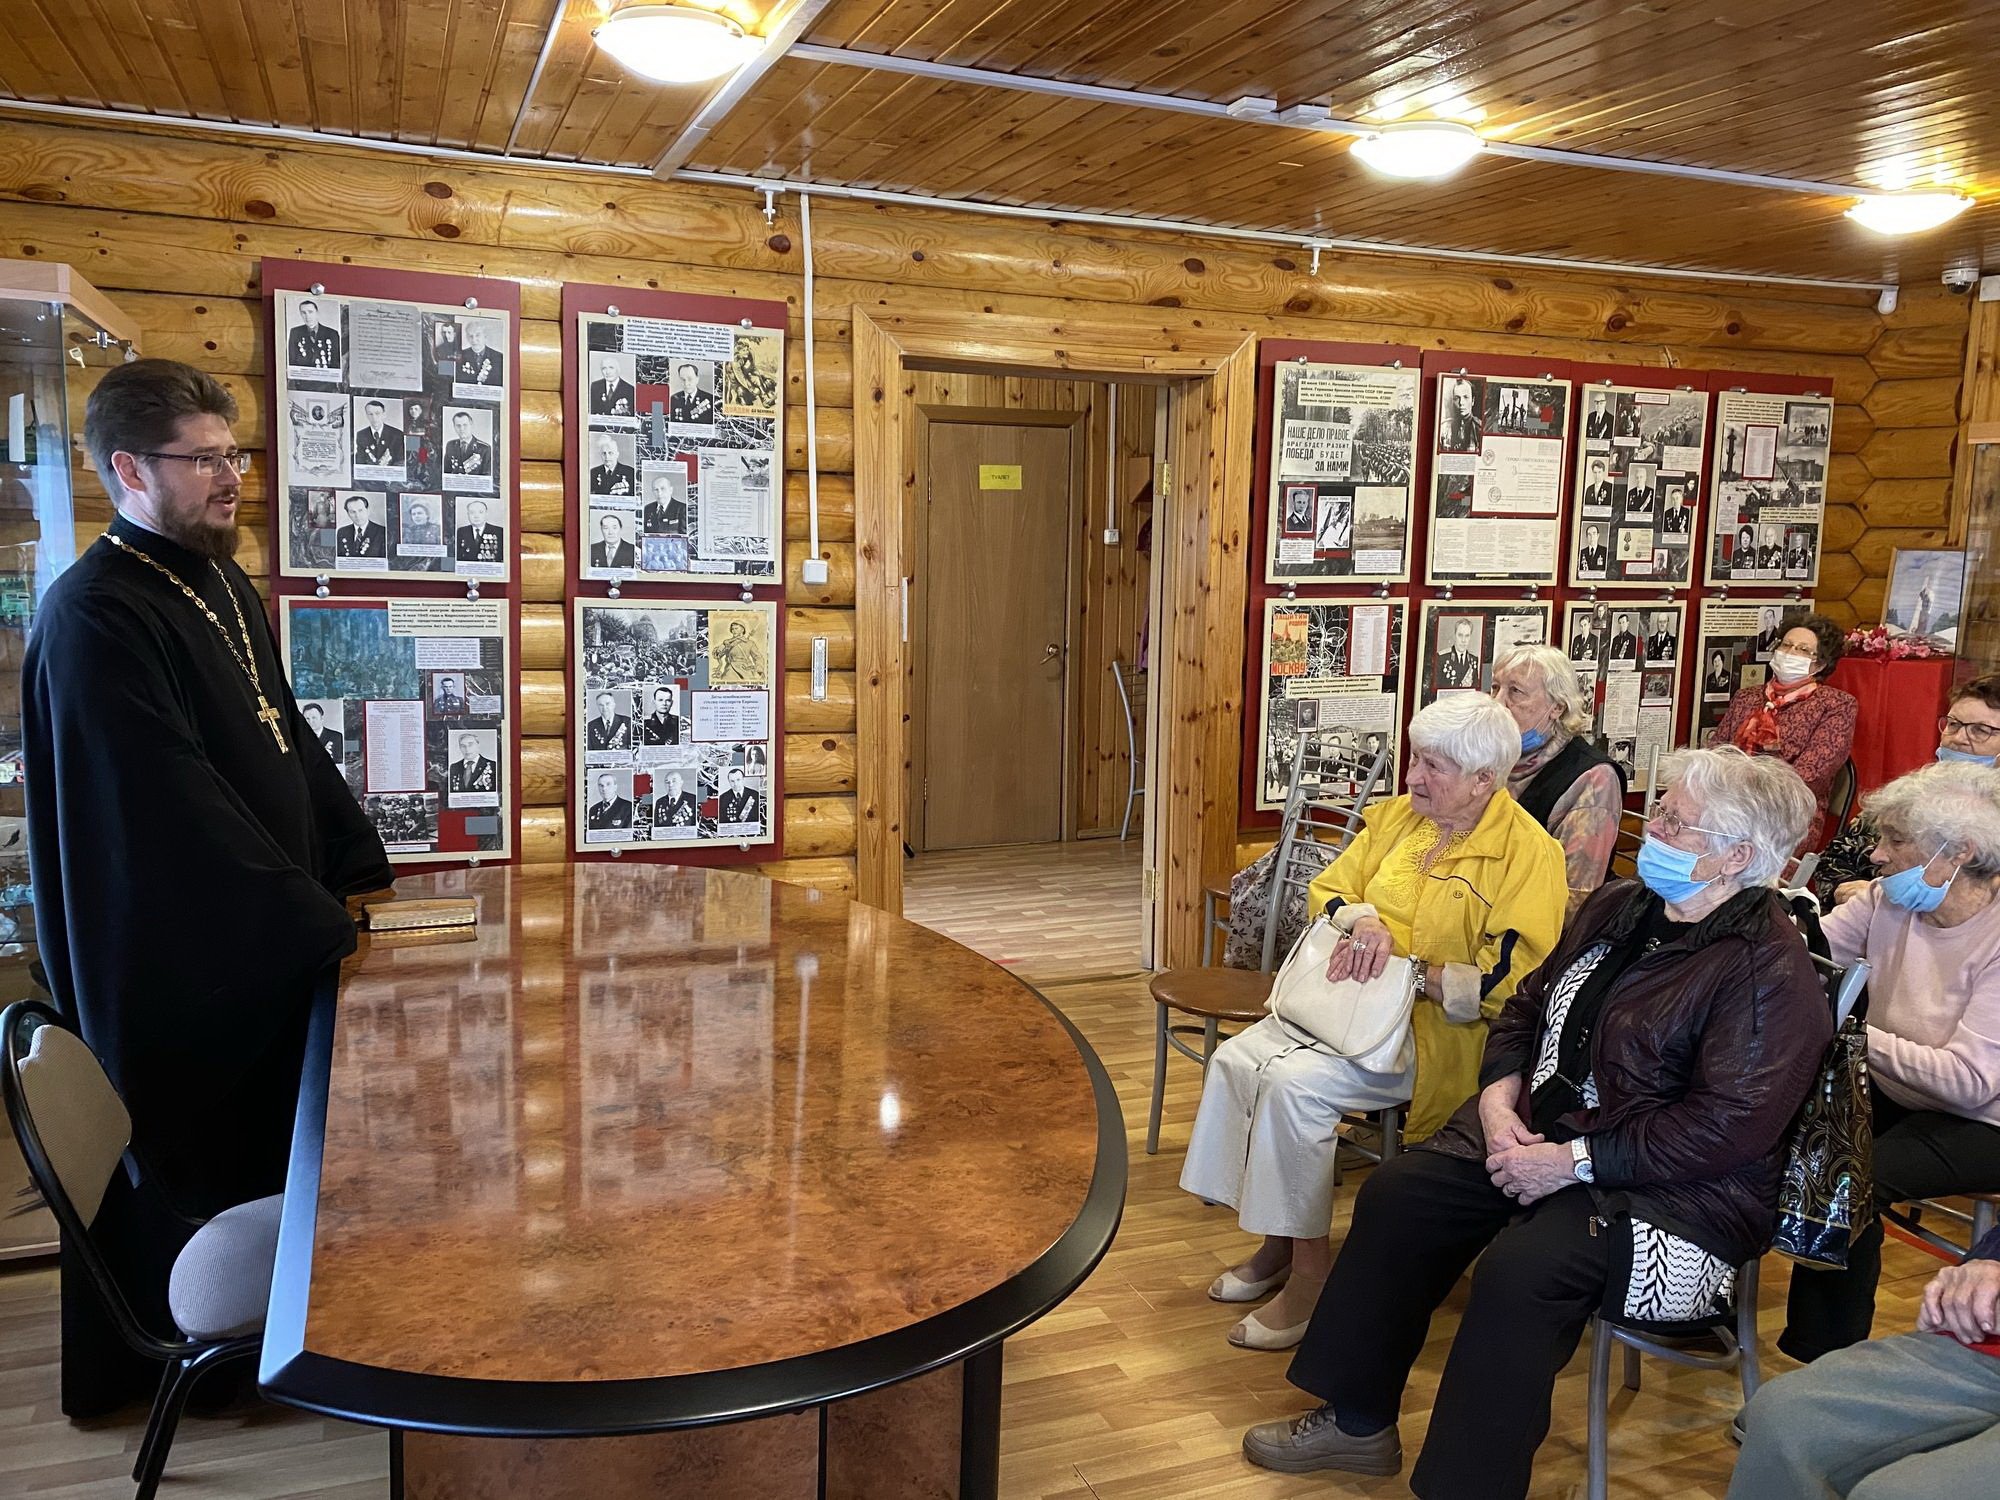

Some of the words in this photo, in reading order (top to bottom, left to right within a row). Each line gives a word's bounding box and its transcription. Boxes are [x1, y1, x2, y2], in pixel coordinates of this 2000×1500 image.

[1288, 426, 1306, 438] НАШЕ
[1307, 427, 1326, 440] ДЕЛО
[1286, 448, 1314, 460] ПОБЕДА
[1320, 451, 1344, 459] БУДЕТ
[1315, 461, 1324, 471] ЗА
[1327, 461, 1349, 471] НАМИ!
[1272, 662, 1306, 674] МОСКВУ
